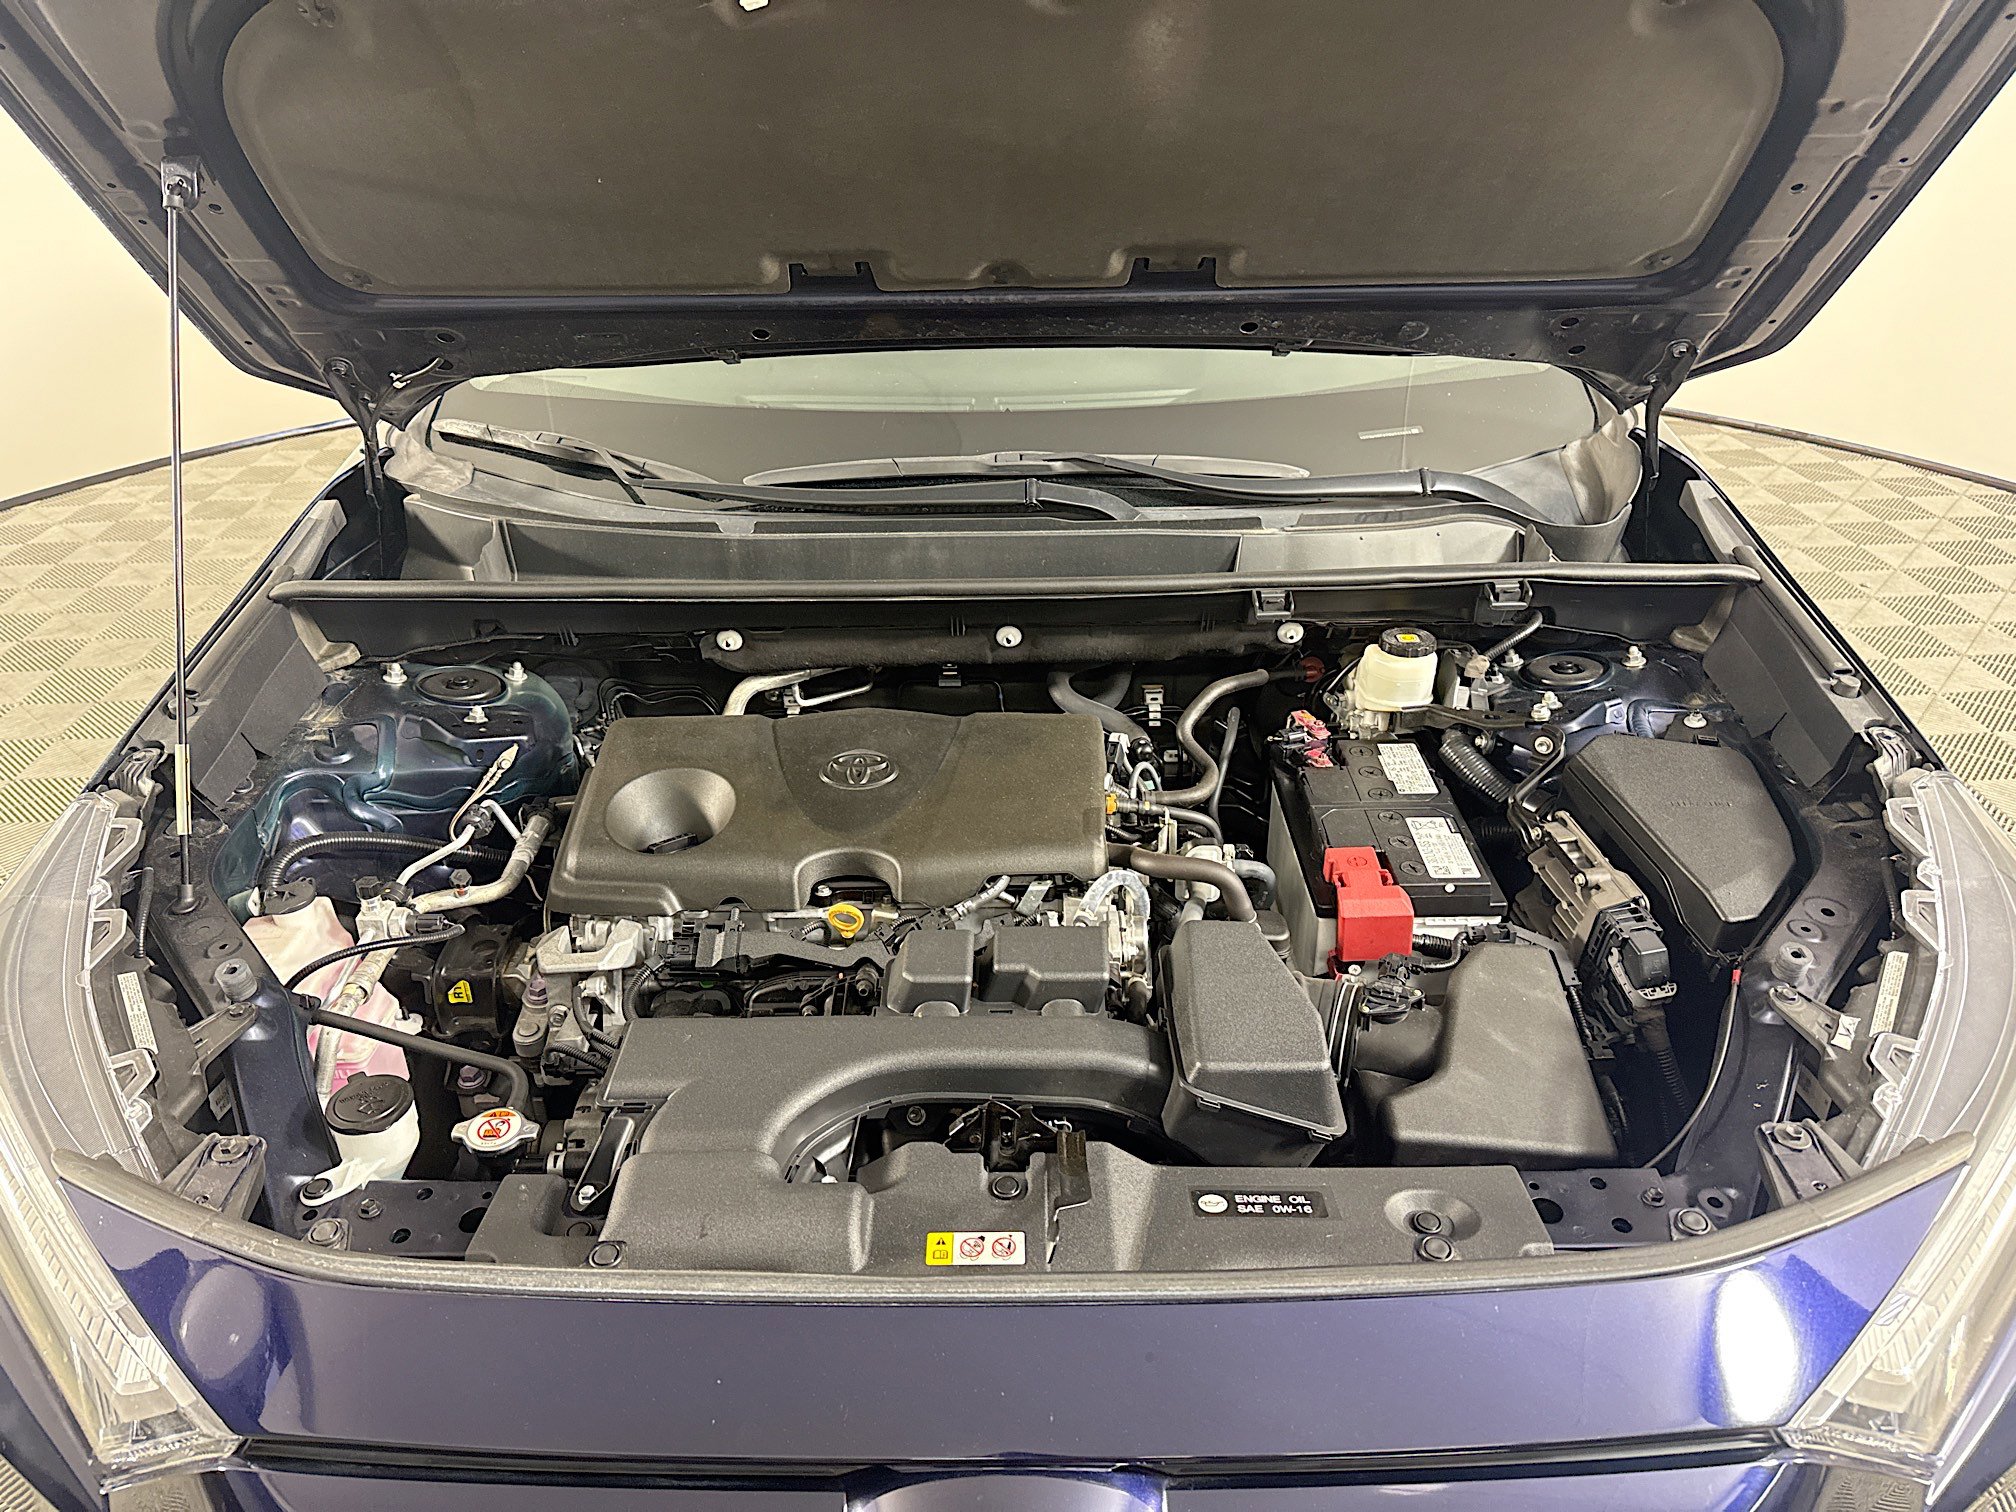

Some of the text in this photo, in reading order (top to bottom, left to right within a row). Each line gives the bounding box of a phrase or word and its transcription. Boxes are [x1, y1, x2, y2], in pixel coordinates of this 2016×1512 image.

[1234, 1194, 1311, 1204] ENGINE OIL
[1237, 1204, 1313, 1214] SAE 0W-16
